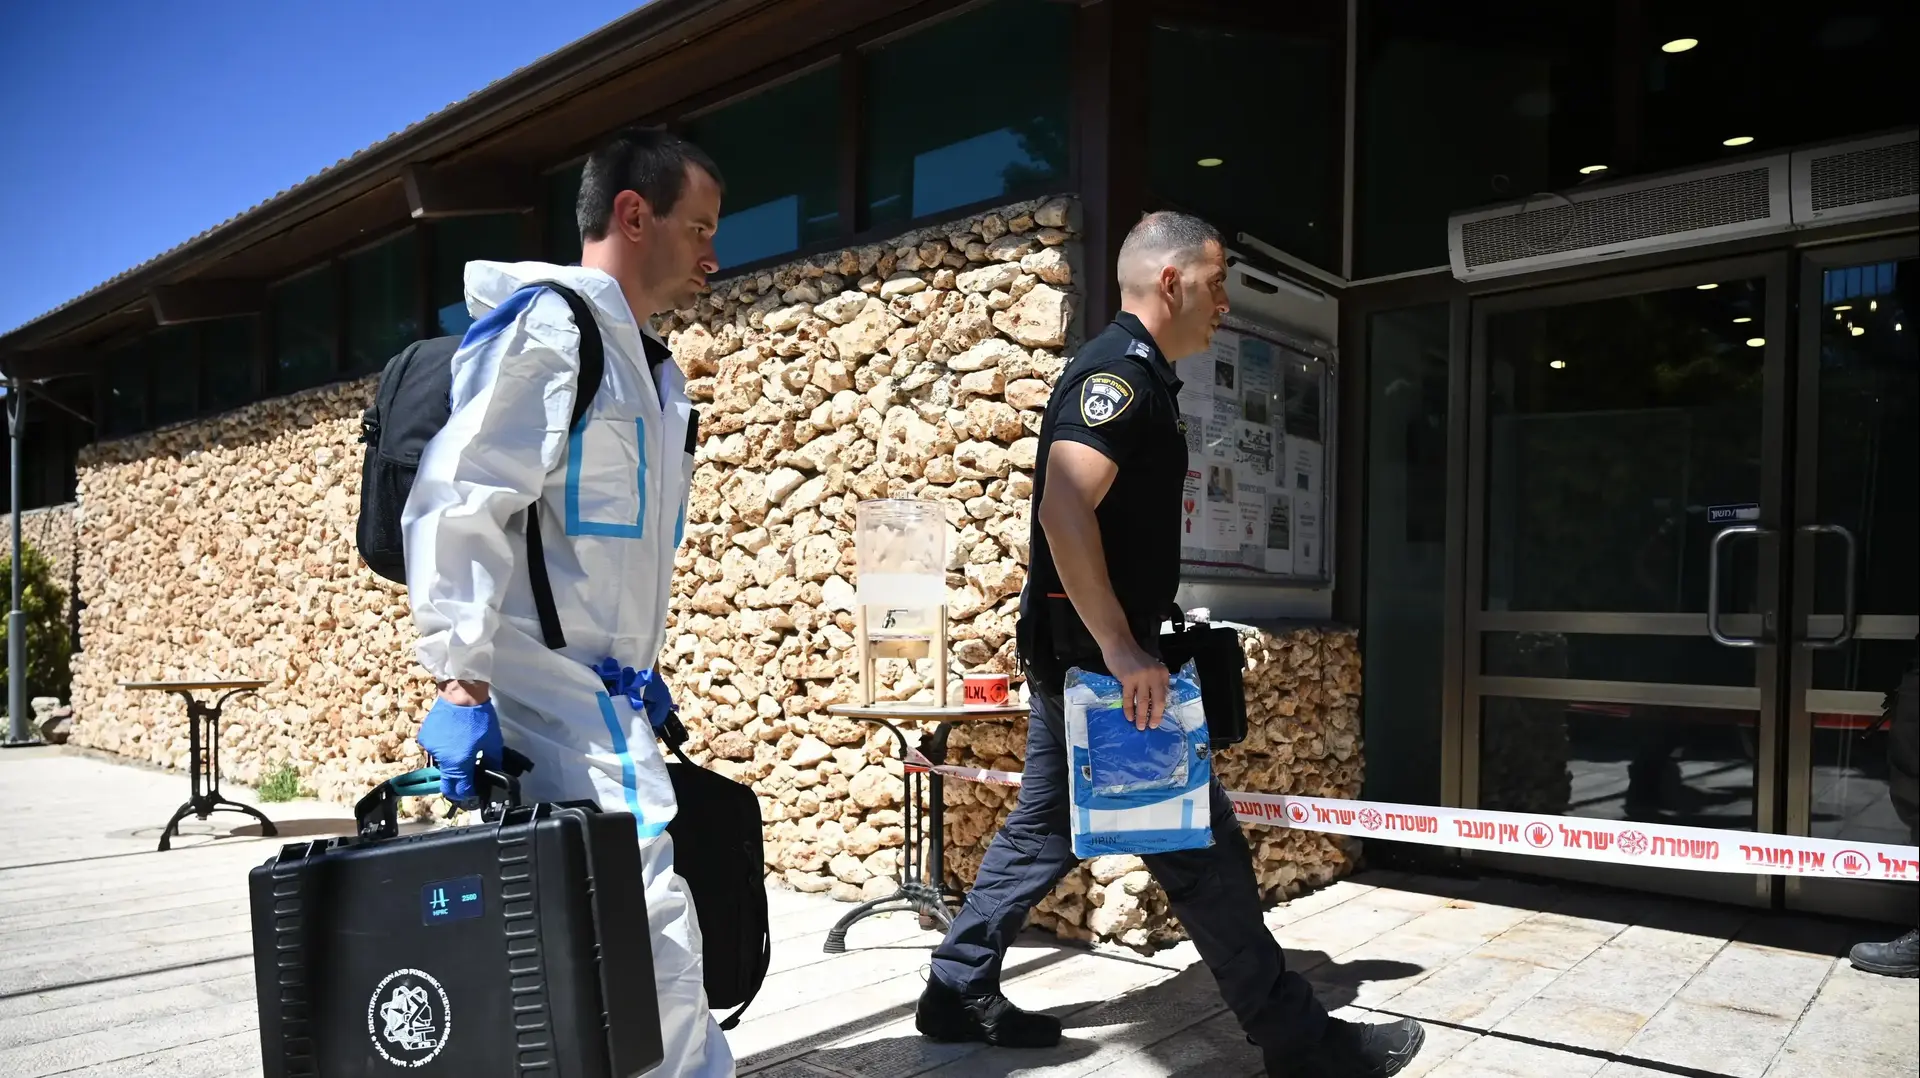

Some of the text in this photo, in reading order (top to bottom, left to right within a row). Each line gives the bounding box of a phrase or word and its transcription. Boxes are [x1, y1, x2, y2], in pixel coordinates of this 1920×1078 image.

[1264, 803, 1283, 820] אין
[1311, 803, 1356, 825] ישראל
[1385, 813, 1438, 833] משטרת
[1453, 819, 1495, 840] מעבר
[1498, 823, 1519, 845] אין
[1558, 824, 1614, 851] ישראל
[1650, 836, 1720, 860] משטרת
[1797, 850, 1825, 873] אין
[1877, 852, 1919, 879] ראל
[368, 969, 451, 1034] IDENTIFICATION AND FORENSIC SCIENCE
